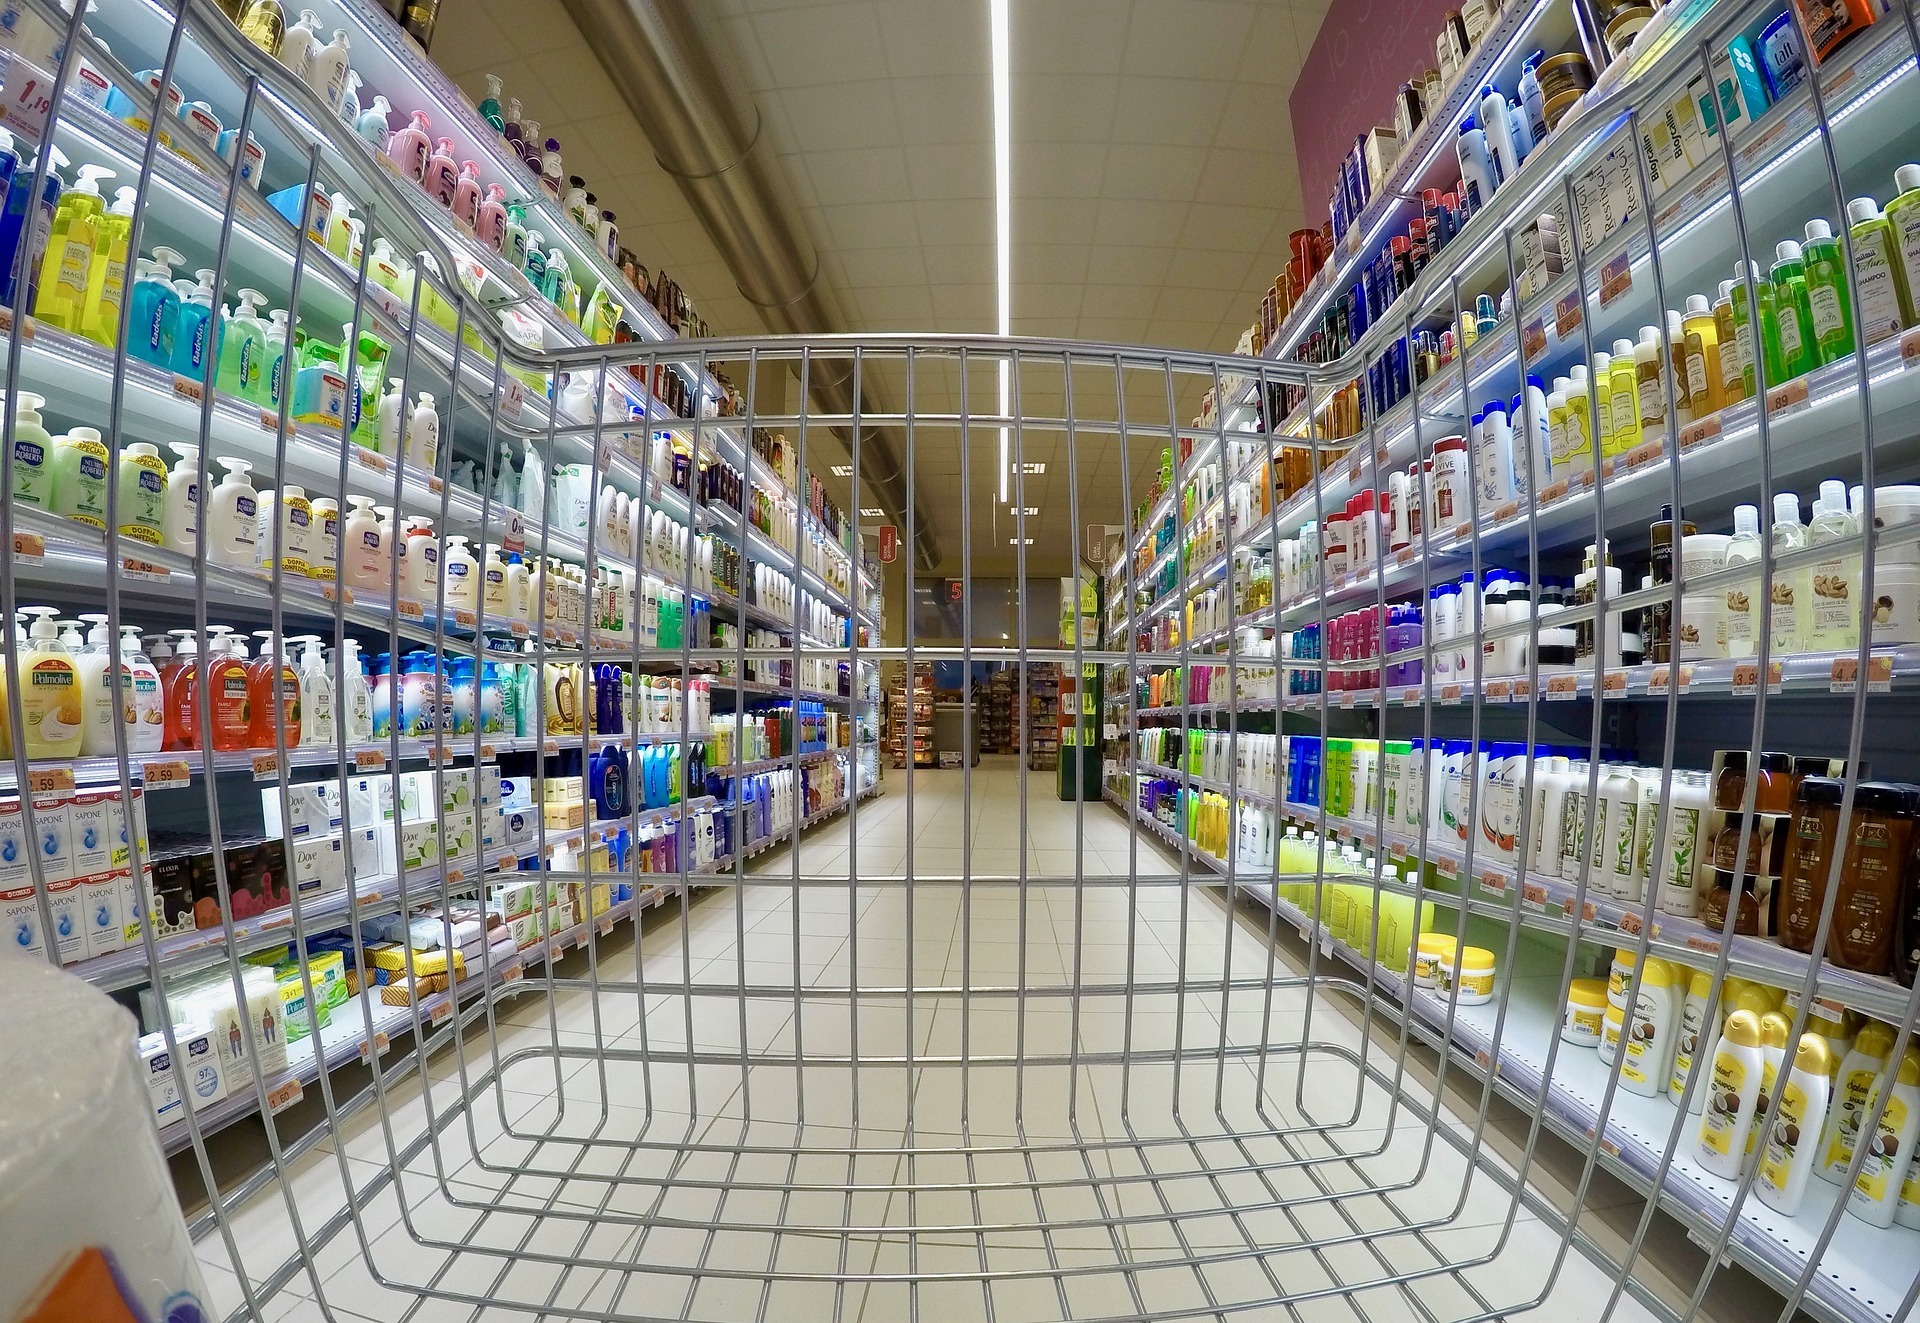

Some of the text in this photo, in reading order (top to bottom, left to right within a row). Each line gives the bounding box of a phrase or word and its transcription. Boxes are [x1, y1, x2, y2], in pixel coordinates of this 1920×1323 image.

[1773, 42, 1795, 67] taft
[19, 79, 50, 115] 1,19
[1615, 145, 1638, 215] RestivOil
[1594, 165, 1614, 233] RestivOil
[1576, 184, 1594, 251] RestivOil
[1553, 202, 1572, 266] RestivOil
[1855, 250, 1877, 263] milmil
[1602, 267, 1613, 282] 10
[1858, 271, 1886, 287] SHAMPOO
[1557, 303, 1567, 317] 10
[152, 304, 163, 347] Badedas
[1523, 329, 1531, 344] 10
[193, 323, 205, 364] Badedas
[241, 342, 250, 383] Badedas
[272, 360, 281, 400] Badedas
[177, 383, 200, 399] 2.19
[263, 415, 278, 428] 2.1
[1682, 428, 1706, 446] 1.89
[18, 445, 41, 455] NEUTRO
[77, 443, 107, 456] SPECIALE
[15, 450, 43, 463] ROBERTS
[135, 456, 163, 469] SPECIALE
[1629, 451, 1649, 467] 1.89
[83, 458, 103, 470] NEUTRO
[81, 464, 105, 478] ROBERTS
[140, 478, 163, 491] ROBERTS
[143, 473, 161, 483] NEUTRO
[131, 526, 156, 538] DOPPIA
[511, 517, 525, 535] 0,95
[127, 558, 153, 572] 2.49
[286, 558, 306, 568] DOPPIA
[951, 582, 962, 600] 5
[33, 672, 72, 685] Palmolive
[1653, 675, 1670, 687] 4.4
[1835, 668, 1858, 682] 4.4
[224, 680, 246, 690] Palmolive
[257, 761, 277, 773] 2.59
[359, 756, 375, 766] 3.68
[149, 770, 173, 783] 2.59
[29, 778, 55, 793] .59
[40, 799, 59, 808] CONAD
[80, 795, 98, 803] CONAD
[75, 810, 101, 821] SAPONE
[402, 831, 419, 843] Dove
[297, 850, 318, 864] Dove
[158, 864, 180, 874] ELIXIR
[92, 873, 110, 882] CONAD
[53, 881, 72, 890] CONAD
[12, 889, 31, 898] CONAD
[88, 888, 114, 900] SAPONE
[50, 896, 77, 908] SAPONE
[6, 904, 37, 917] SAPONE
[1623, 918, 1642, 936] 3.90
[285, 988, 297, 1000] 3+1
[190, 1044, 209, 1057] ROBERTS
[191, 1039, 207, 1050] NEUTRO
[153, 1055, 170, 1066] NEUTRO
[197, 1079, 217, 1093] naturale
[1713, 1077, 1736, 1093] SHAMPOO
[1848, 1096, 1866, 1106] SHAM
